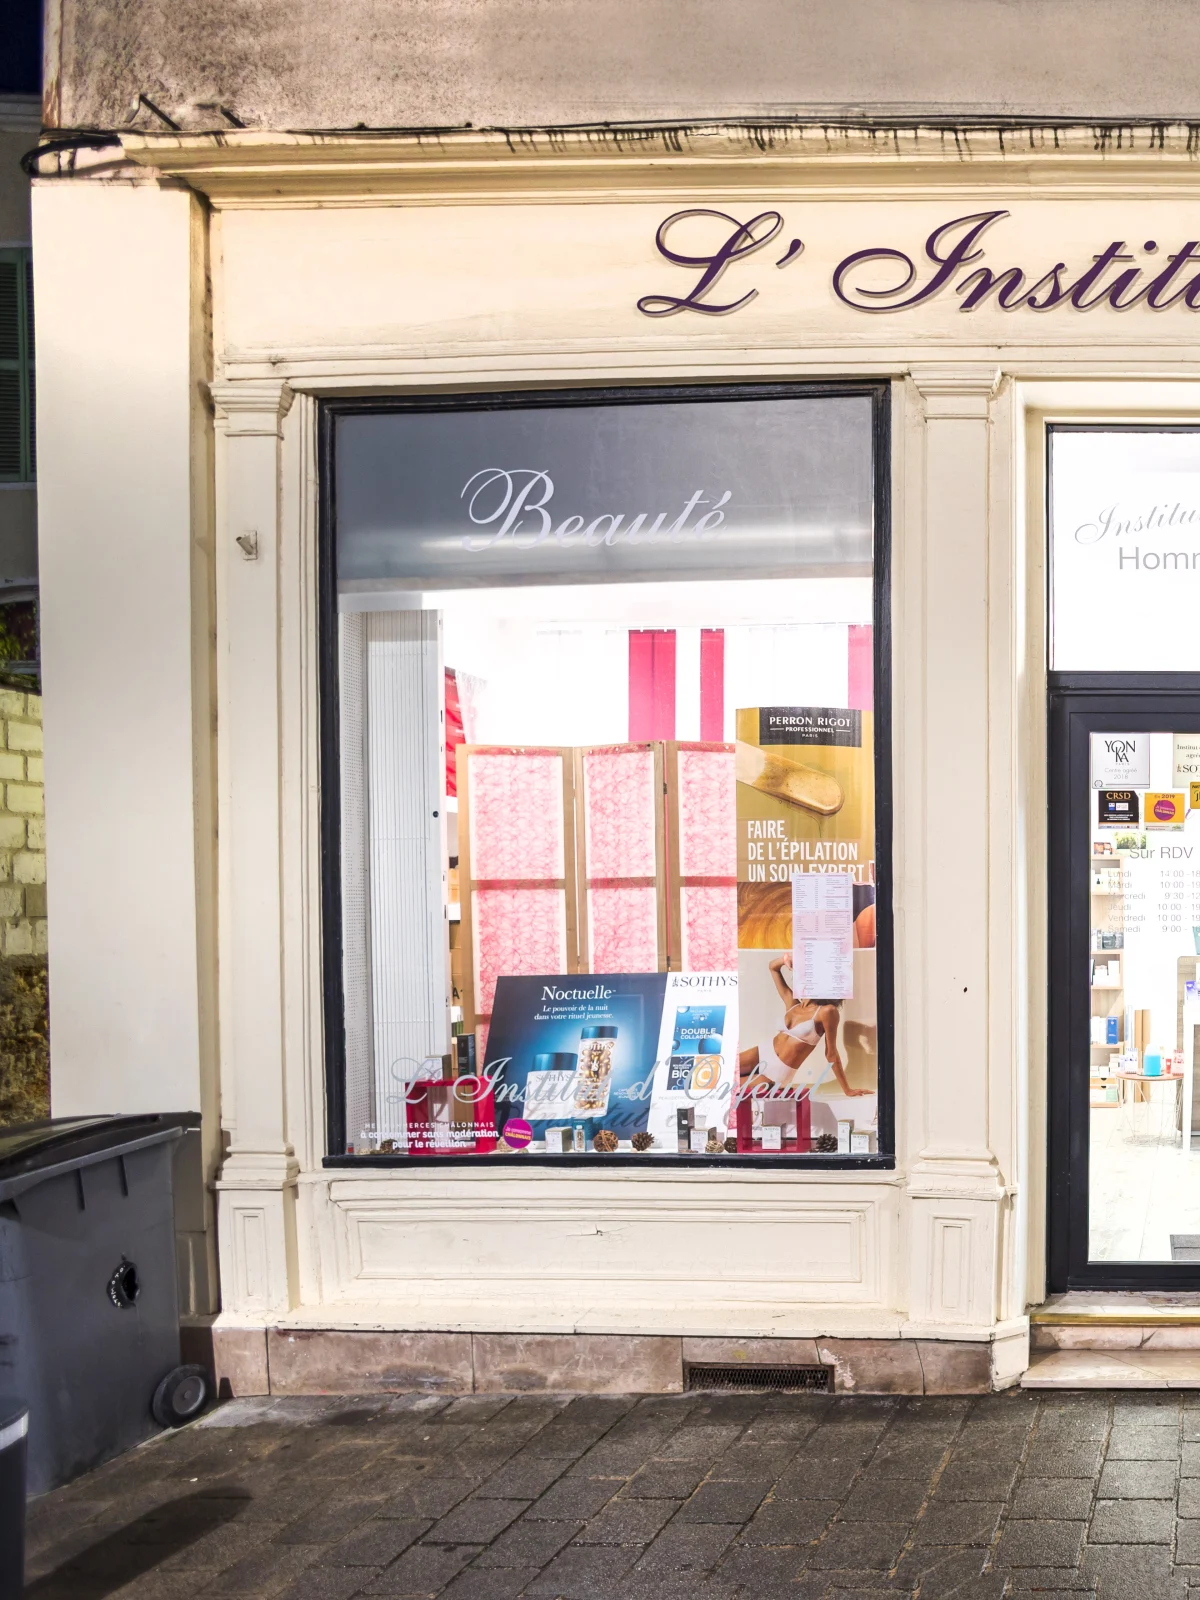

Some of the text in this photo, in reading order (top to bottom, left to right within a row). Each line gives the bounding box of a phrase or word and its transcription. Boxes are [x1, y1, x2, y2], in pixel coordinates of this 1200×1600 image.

[460, 468, 733, 552] Beauté
[769, 716, 850, 727] PERRON RIGOT
[1106, 792, 1131, 800] CRSD
[747, 820, 785, 839] FAIRE
[748, 843, 765, 861] DE
[1129, 847, 1194, 859] Sur RDV
[748, 864, 766, 882] UN
[680, 976, 738, 988] SOTHYS
[541, 985, 612, 1000] Noctuelle
[552, 1005, 578, 1014] pouvoir
[568, 1012, 586, 1020] rituel
[446, 1130, 500, 1140] modération
[392, 1139, 467, 1150] pour le réveillon
